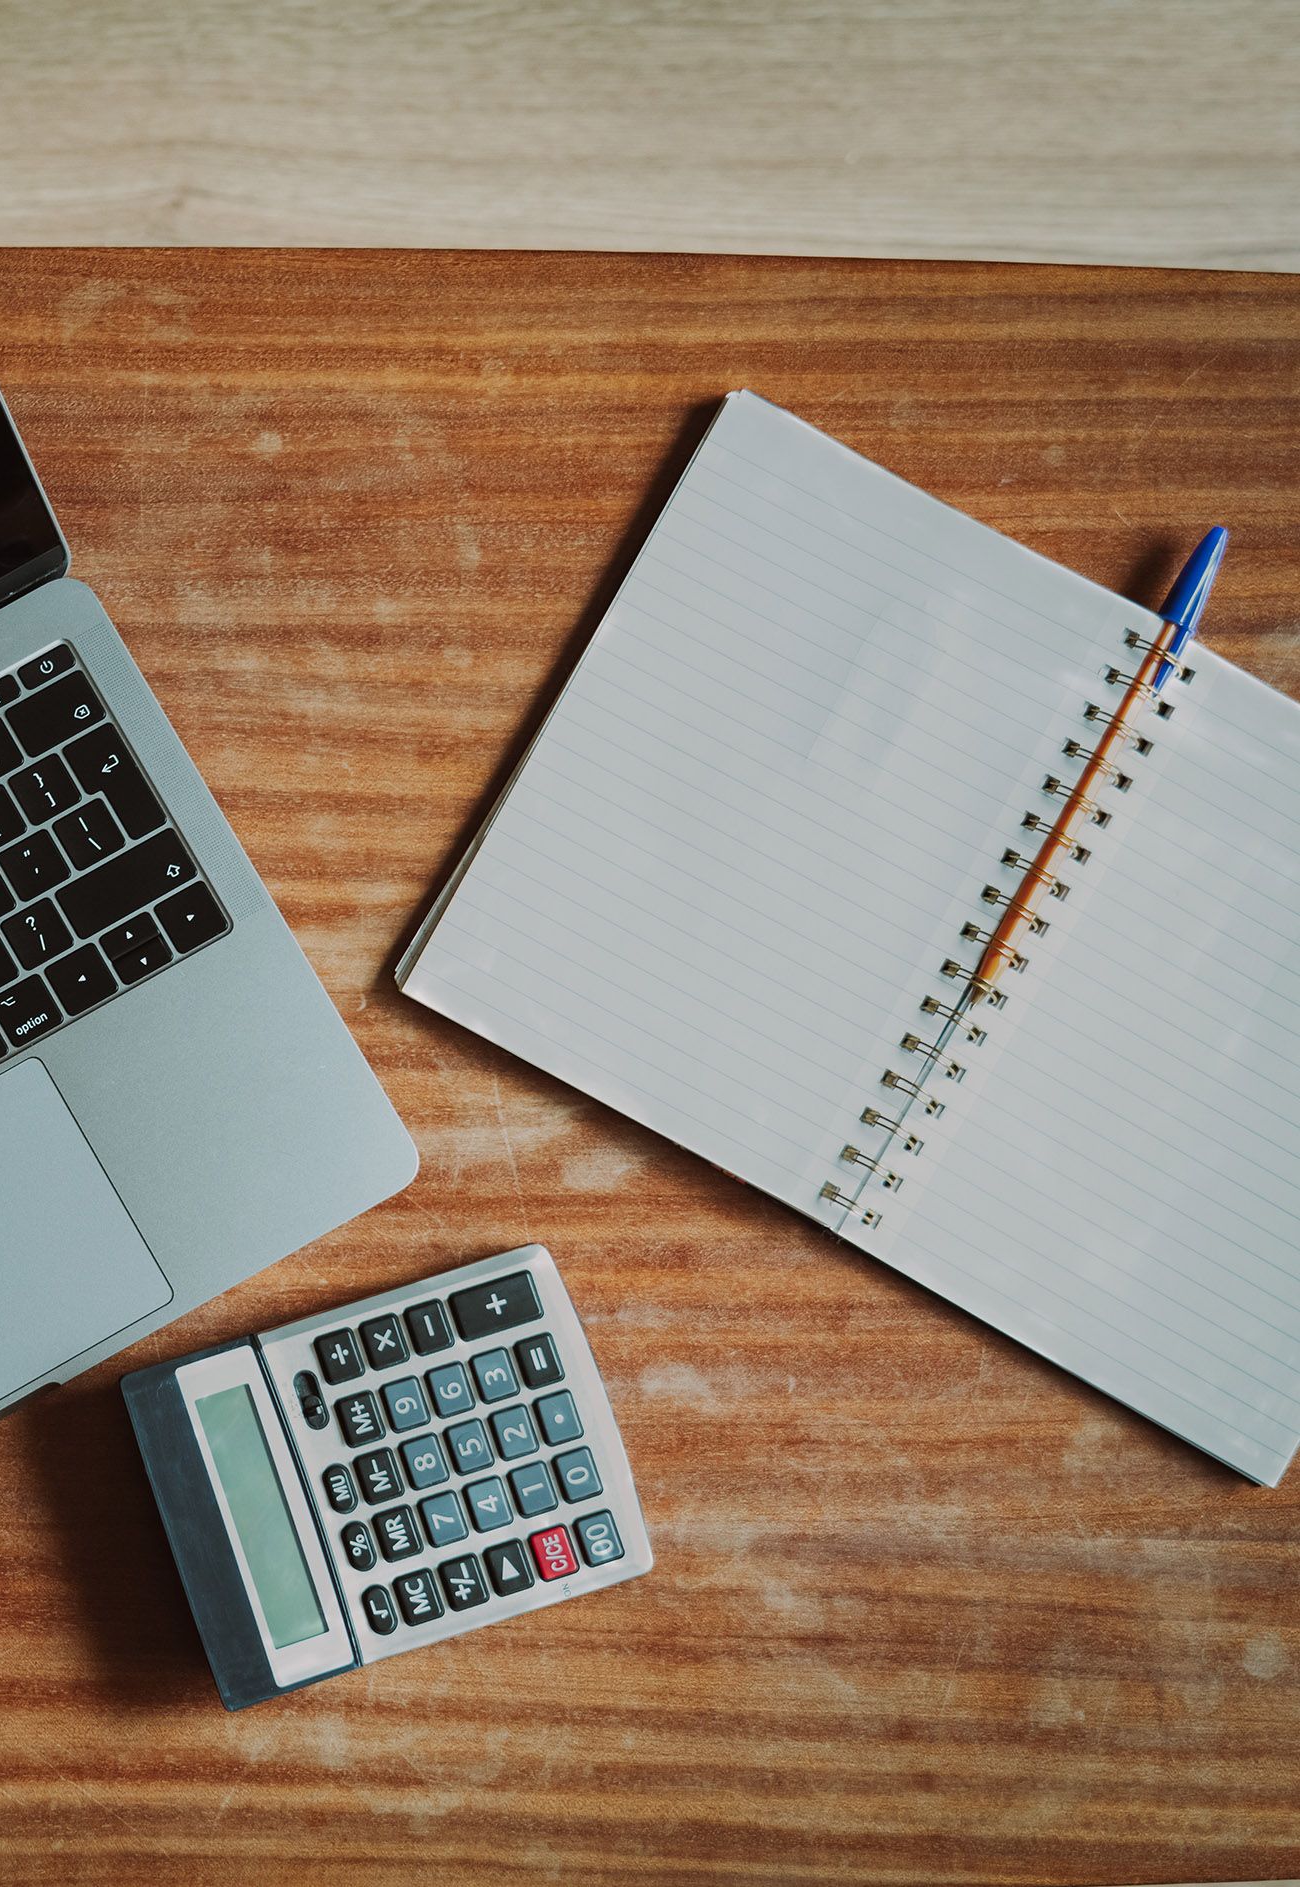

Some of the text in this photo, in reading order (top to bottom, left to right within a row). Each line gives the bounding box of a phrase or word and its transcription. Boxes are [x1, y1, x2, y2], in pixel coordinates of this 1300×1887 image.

[15, 1012, 48, 1036] option
[485, 1368, 507, 1385] 3
[439, 1382, 462, 1399] 6
[395, 1397, 418, 1414] 9
[351, 1400, 375, 1434] M+
[503, 1423, 527, 1442] 2
[458, 1437, 481, 1456] 5
[414, 1453, 436, 1471] 8
[369, 1459, 392, 1493] M-
[566, 1466, 589, 1485] 0
[330, 1475, 350, 1502] MU
[522, 1482, 544, 1496] 1
[477, 1494, 498, 1512] 4
[431, 1514, 455, 1529] 7
[385, 1513, 410, 1551] MR
[590, 1523, 612, 1557] 00
[542, 1533, 569, 1572] C/CE
[405, 1578, 431, 1614] MC
